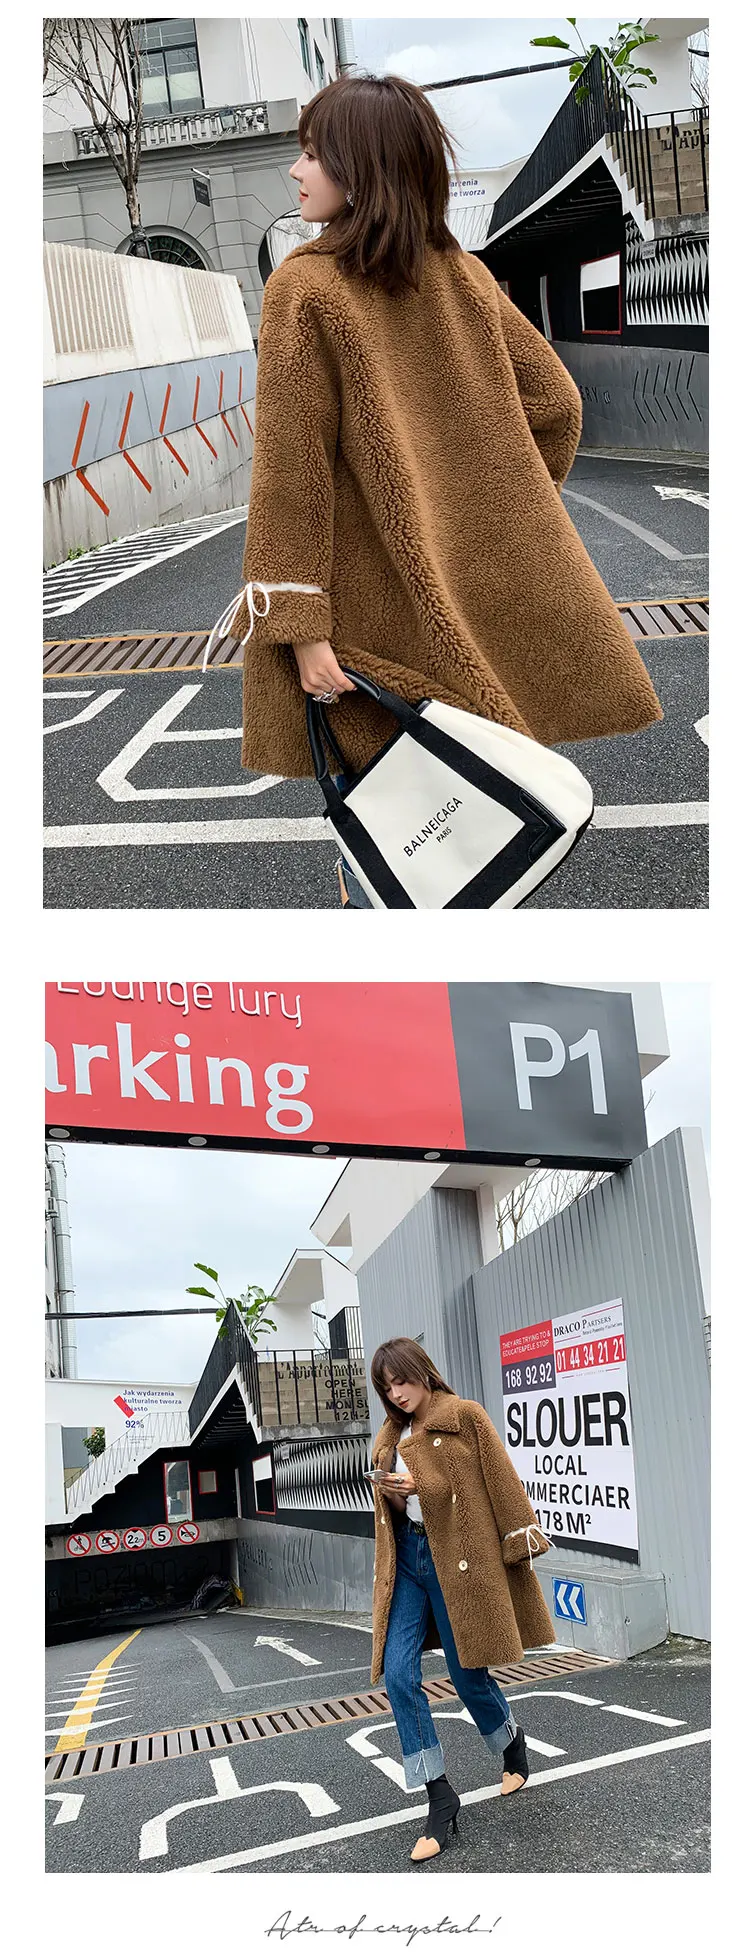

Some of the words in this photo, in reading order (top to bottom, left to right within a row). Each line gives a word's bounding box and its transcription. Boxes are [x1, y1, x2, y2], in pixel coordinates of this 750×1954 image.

[403, 797, 463, 857] BALNEICAGA
[436, 826, 452, 843] PARIS
[509, 1022, 608, 1115] P1
[554, 1322, 580, 1337] DRACO
[557, 1350, 567, 1371] 01
[570, 1347, 581, 1369] 44
[583, 1343, 595, 1366] 34
[598, 1340, 609, 1364] 21
[613, 1337, 624, 1361] 21
[505, 1368, 522, 1389] 168
[525, 1364, 538, 1386] 92
[539, 1361, 553, 1383] 92
[507, 1391, 630, 1447] SLOUER
[534, 1454, 588, 1476] LOCAL
[157, 1530, 167, 1542] 5
